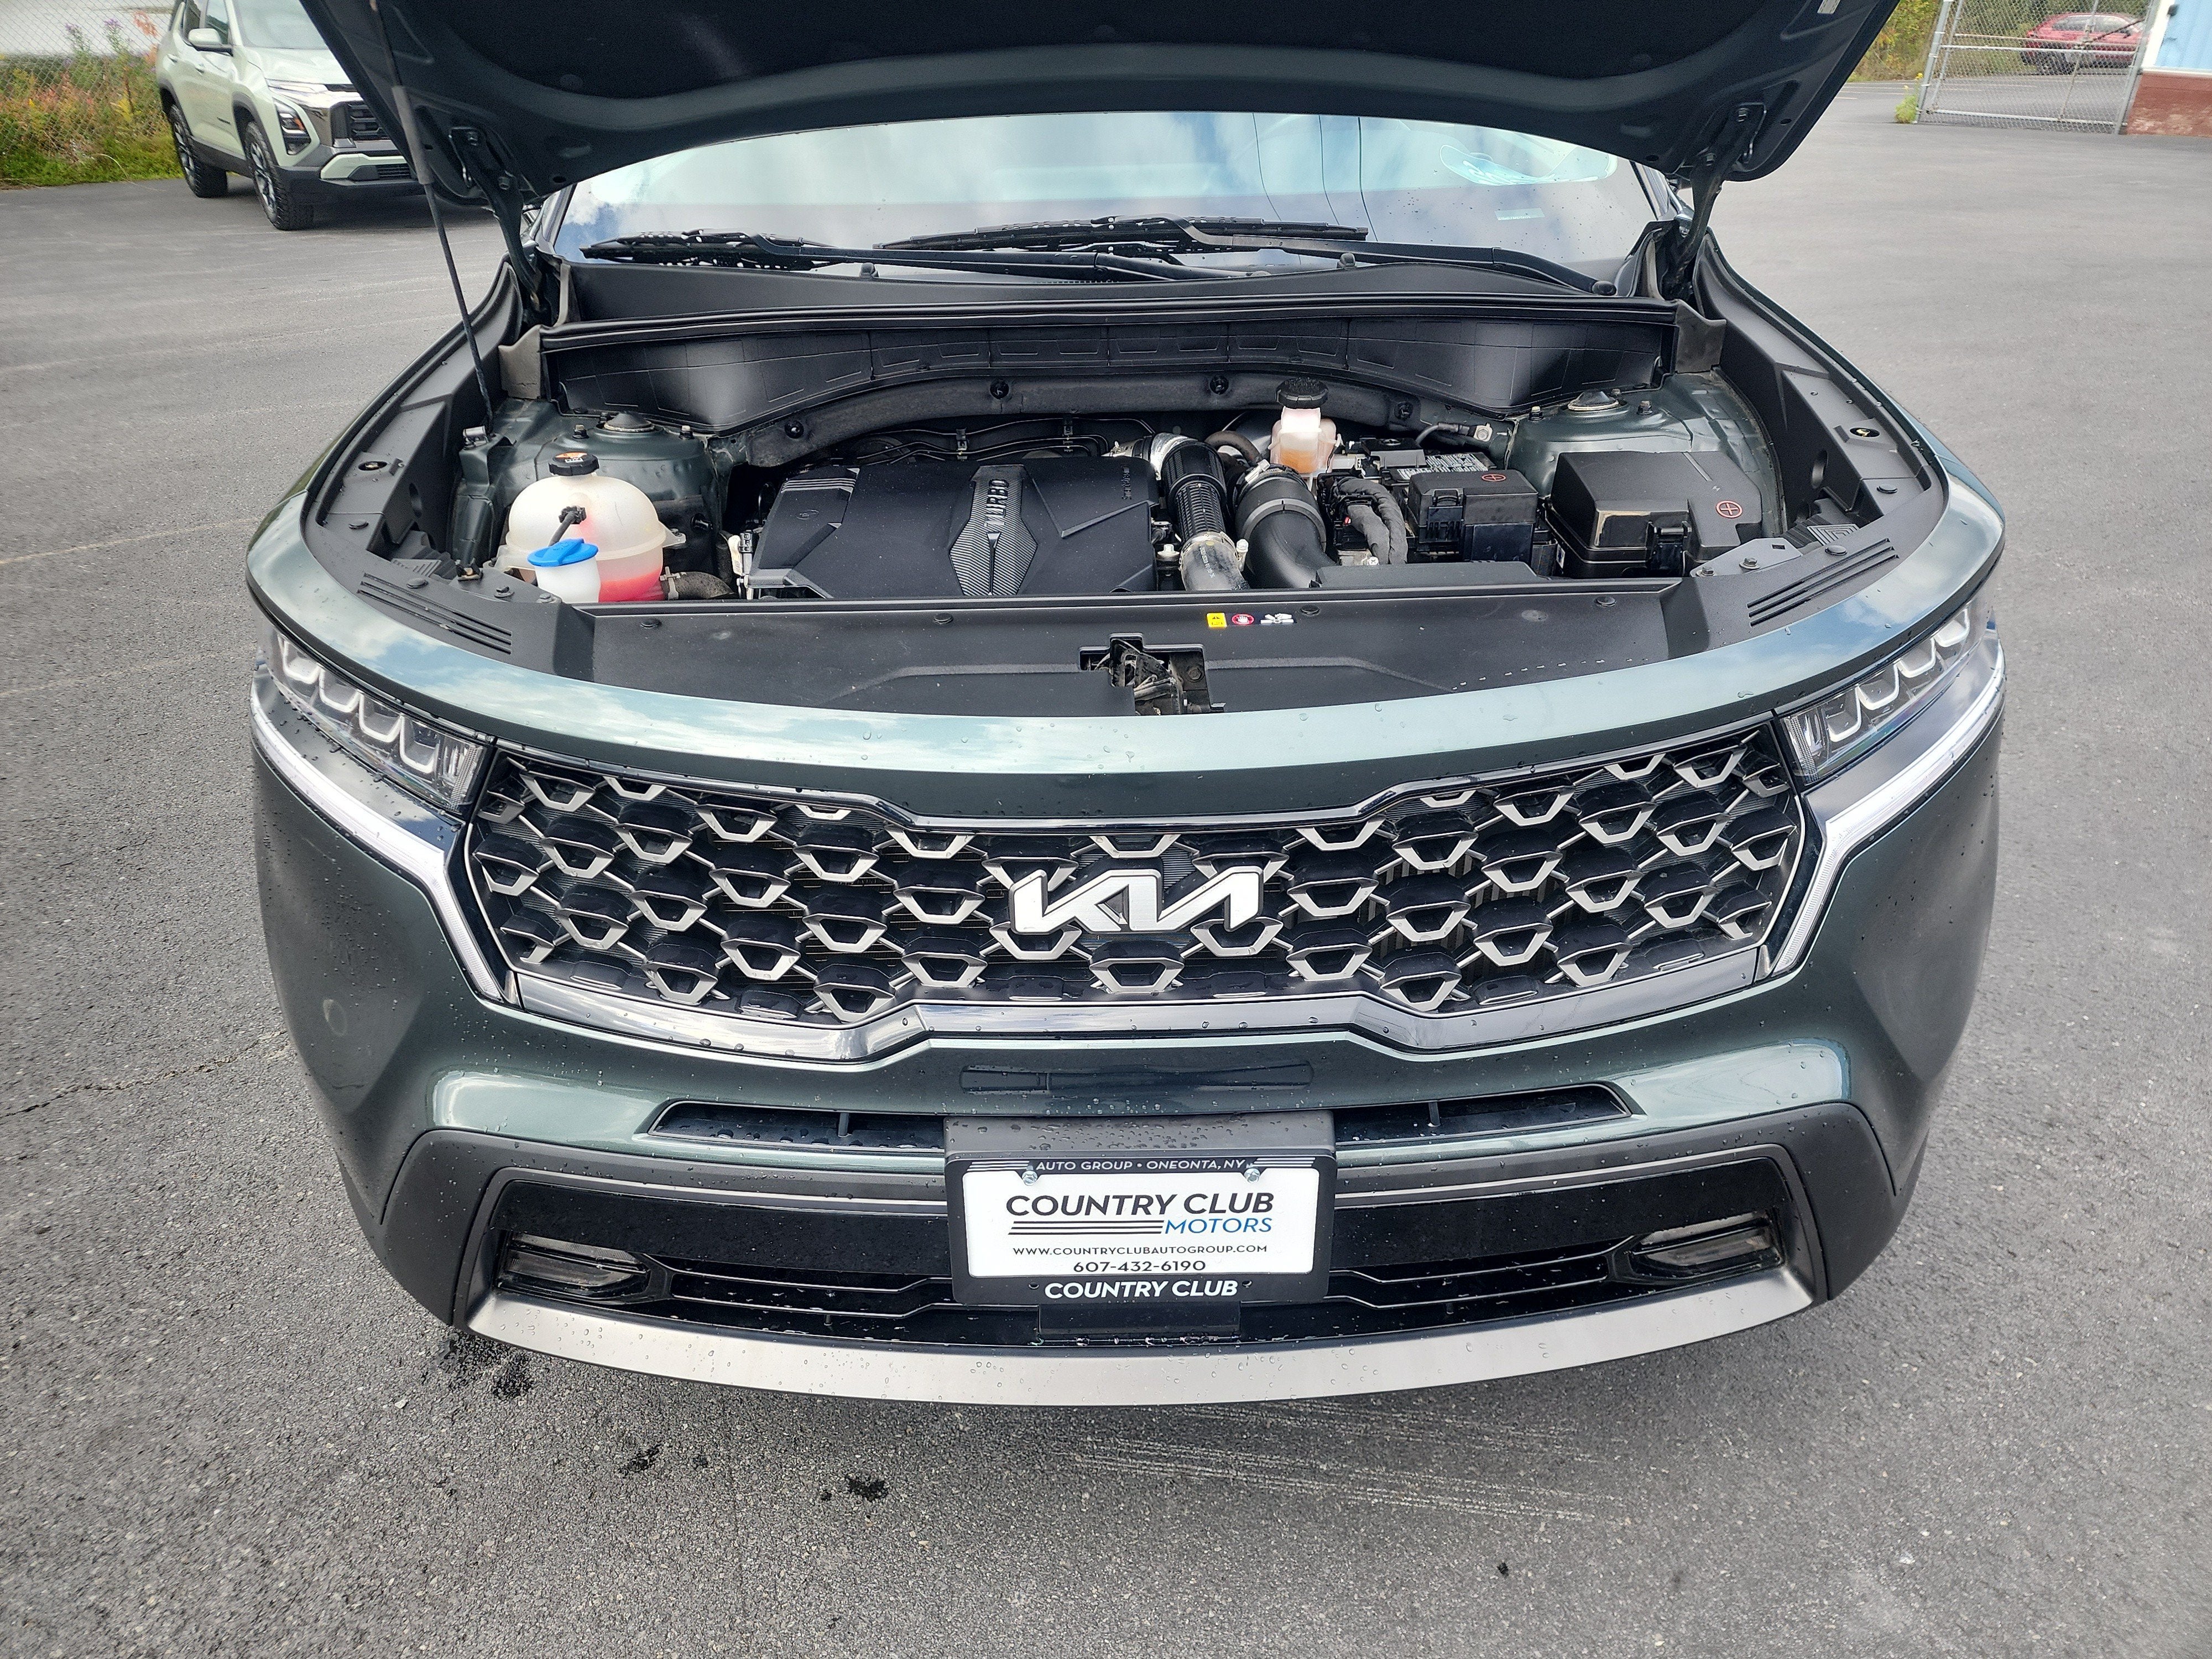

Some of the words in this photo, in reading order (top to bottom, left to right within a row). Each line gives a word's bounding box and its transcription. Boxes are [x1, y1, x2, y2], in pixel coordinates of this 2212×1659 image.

[984, 479, 1009, 526] TURBO
[1009, 865, 1264, 935] KIA
[1035, 1161, 1076, 1170] AUTO
[1081, 1161, 1133, 1170] GROUP
[1006, 1194, 1177, 1216] COUNTRY
[1183, 1192, 1274, 1214] CLUB
[1165, 1217, 1272, 1234] MOTORS
[1013, 1245, 1267, 1255] WWW.COUNTRYCLUBAUTOGROUP.COM
[1073, 1260, 1206, 1272] 607-432-6190
[1045, 1281, 1169, 1299] COUNTRY
[1172, 1280, 1238, 1297] CLUB
